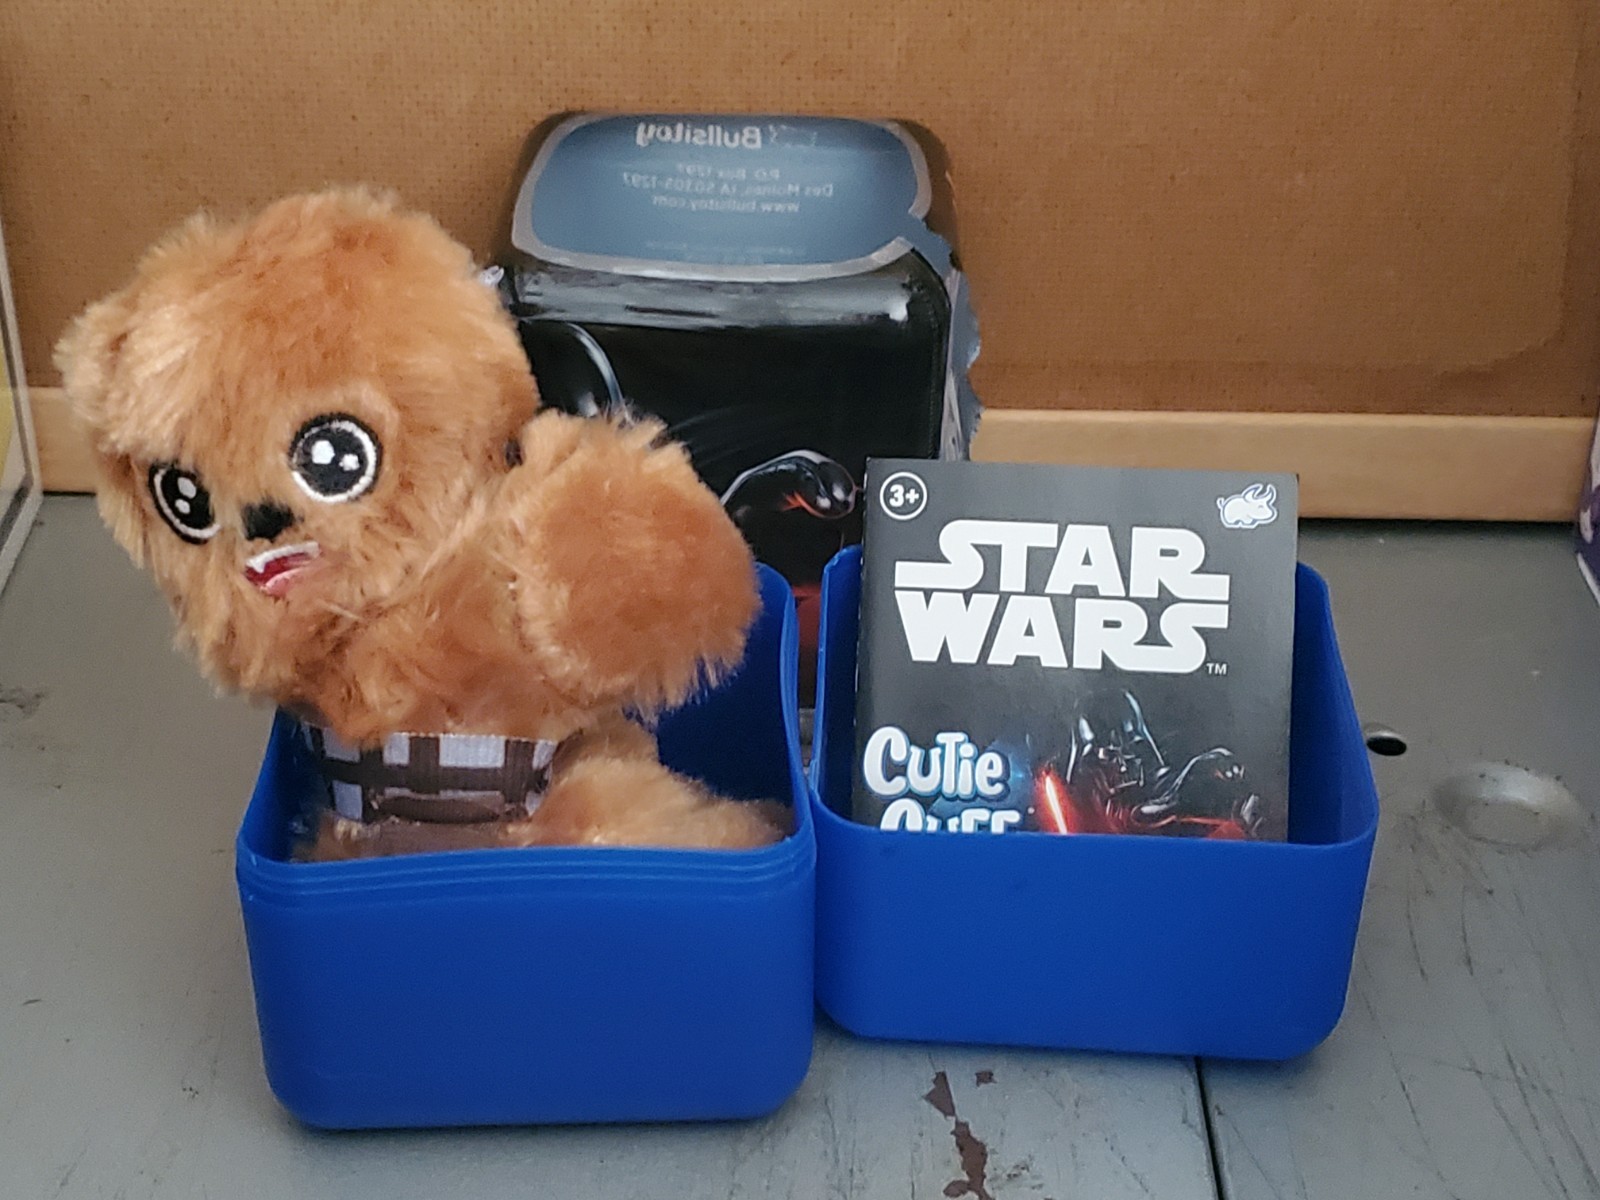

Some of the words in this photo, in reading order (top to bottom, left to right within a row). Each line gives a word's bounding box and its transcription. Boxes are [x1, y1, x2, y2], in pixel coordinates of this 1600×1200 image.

[889, 484, 920, 507] 3+
[894, 519, 1230, 602] STAR
[894, 590, 1229, 674] WARS
[1206, 662, 1227, 676] TM
